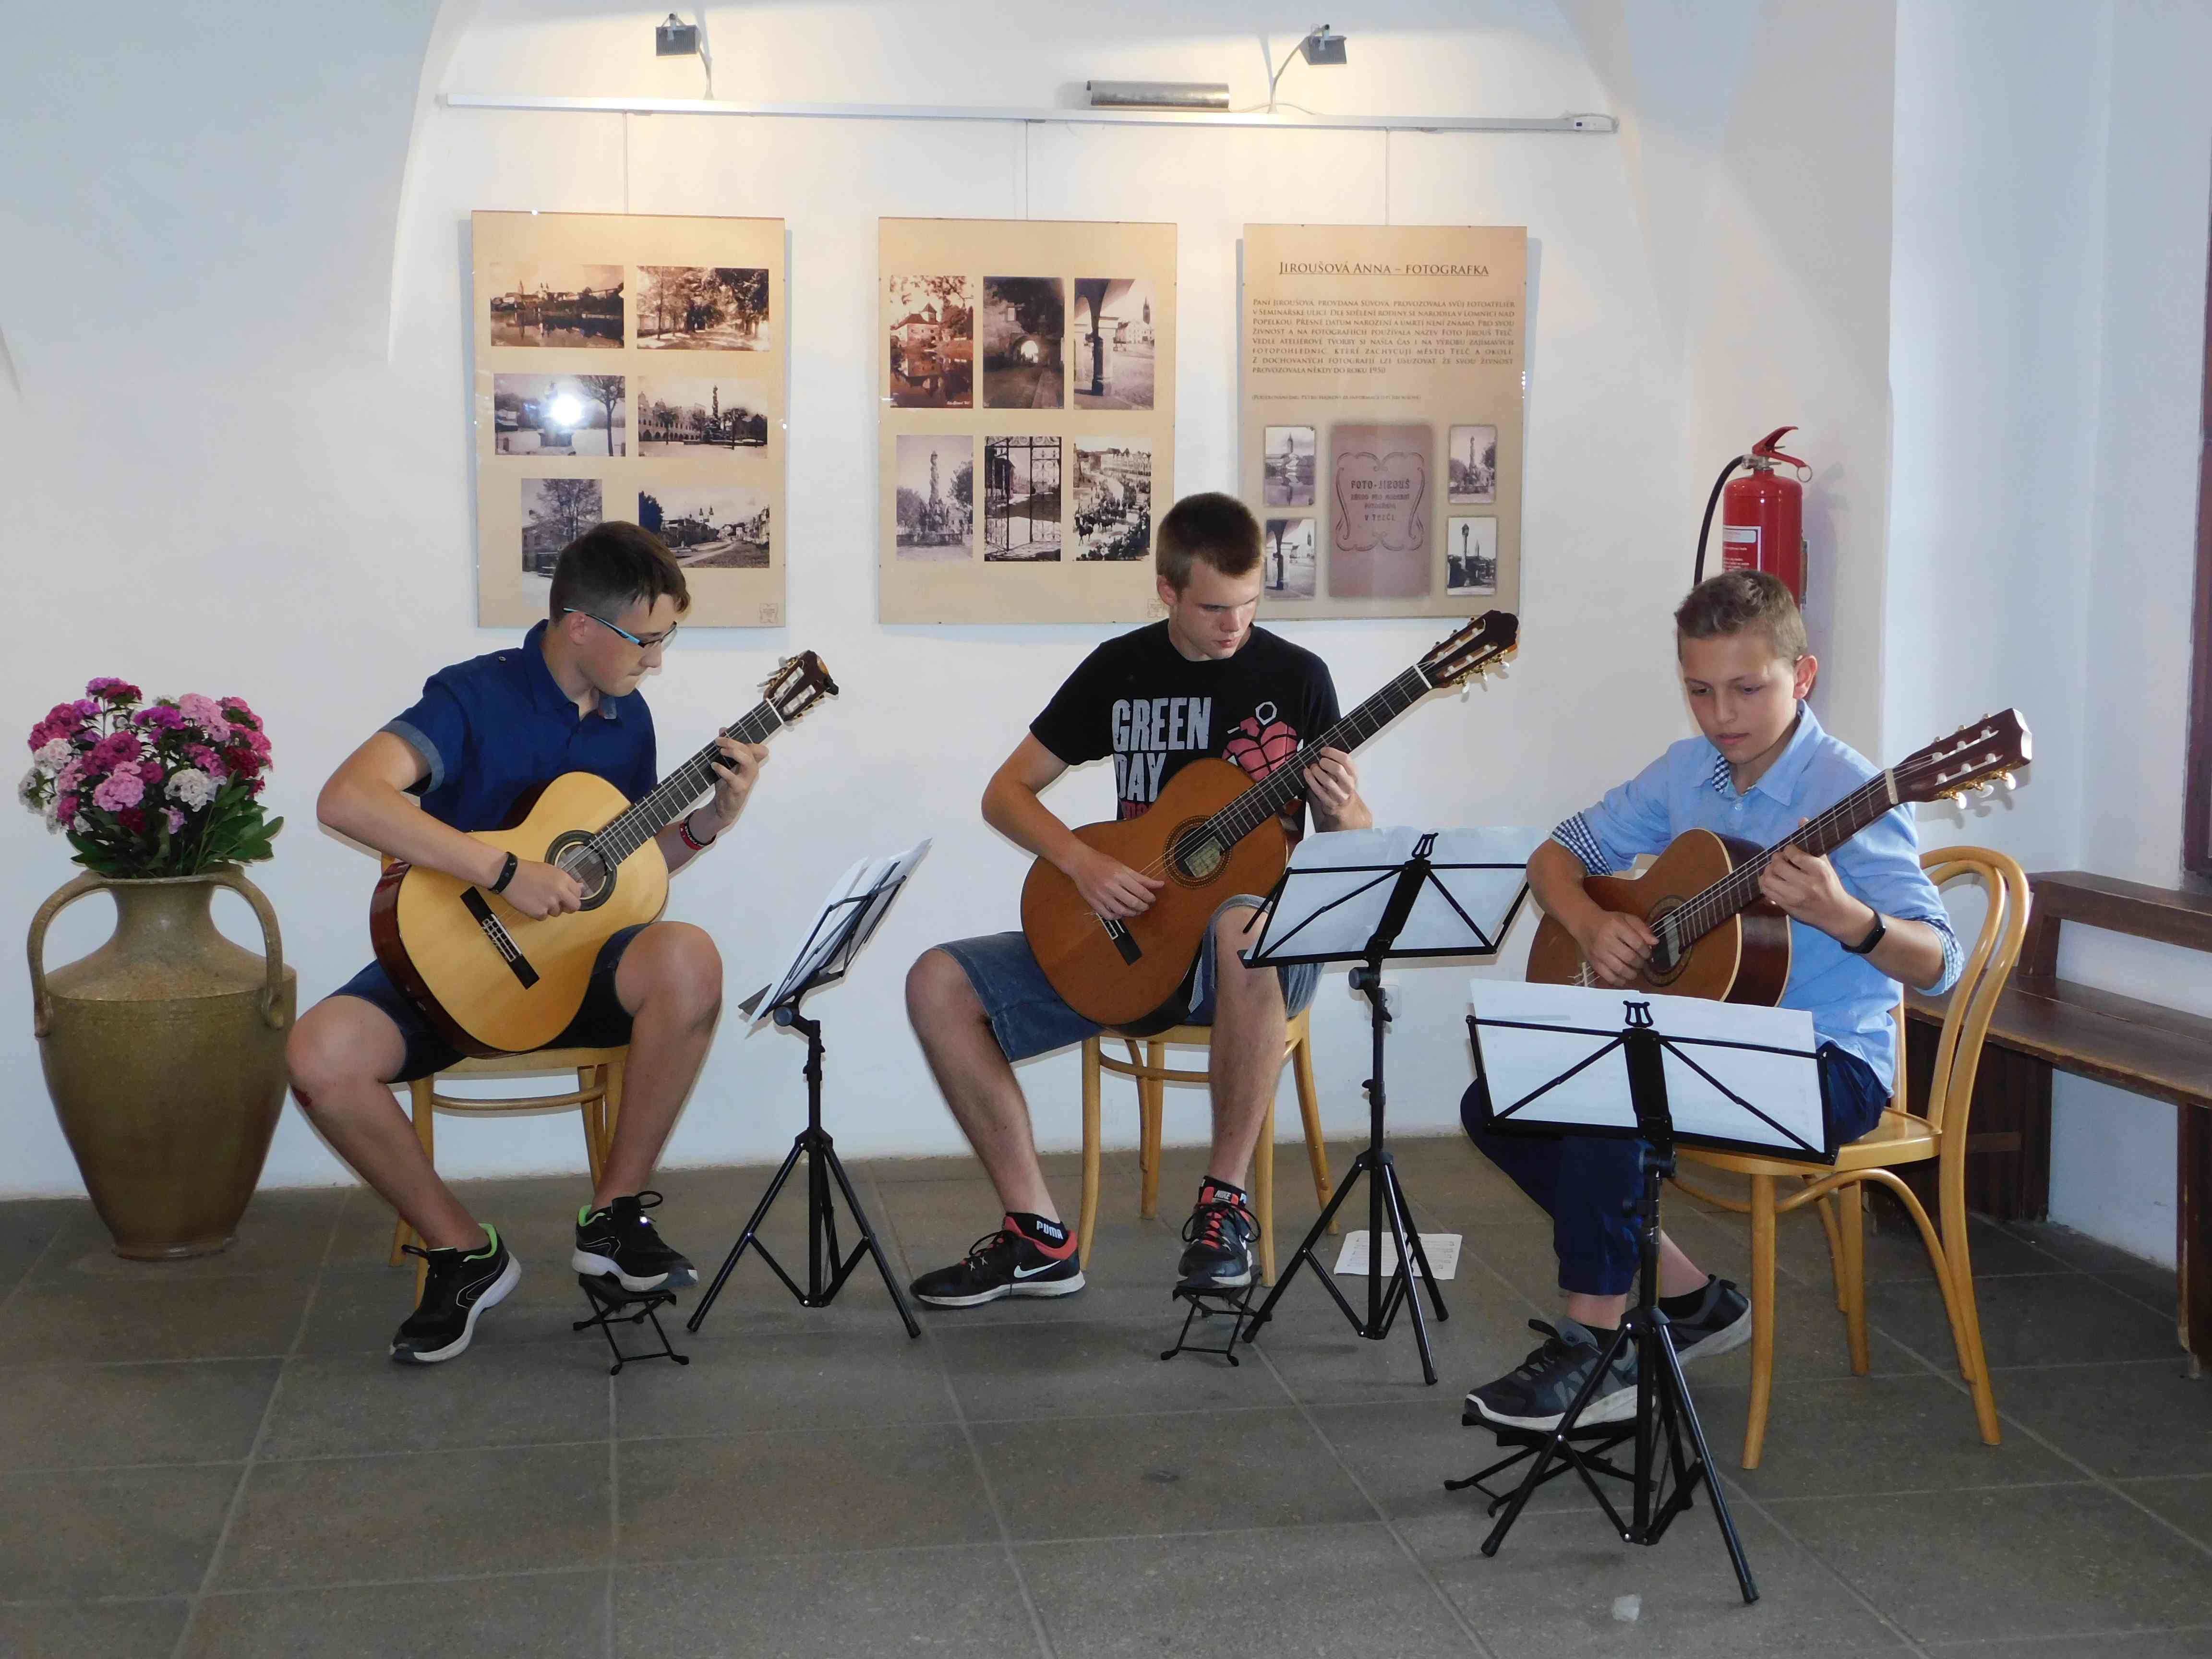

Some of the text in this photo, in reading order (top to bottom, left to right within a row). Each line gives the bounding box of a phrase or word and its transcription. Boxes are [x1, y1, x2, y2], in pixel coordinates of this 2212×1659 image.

[1279, 261, 1350, 274] JIROUŠOVÁ
[1353, 263, 1391, 274] ANNA
[1406, 264, 1489, 275] FOTOGRAFKA
[1112, 697, 1211, 752] GREEN
[1114, 753, 1166, 802] DAY
[1214, 1190, 1232, 1200] NIKE
[1036, 1220, 1063, 1239] PUMA
